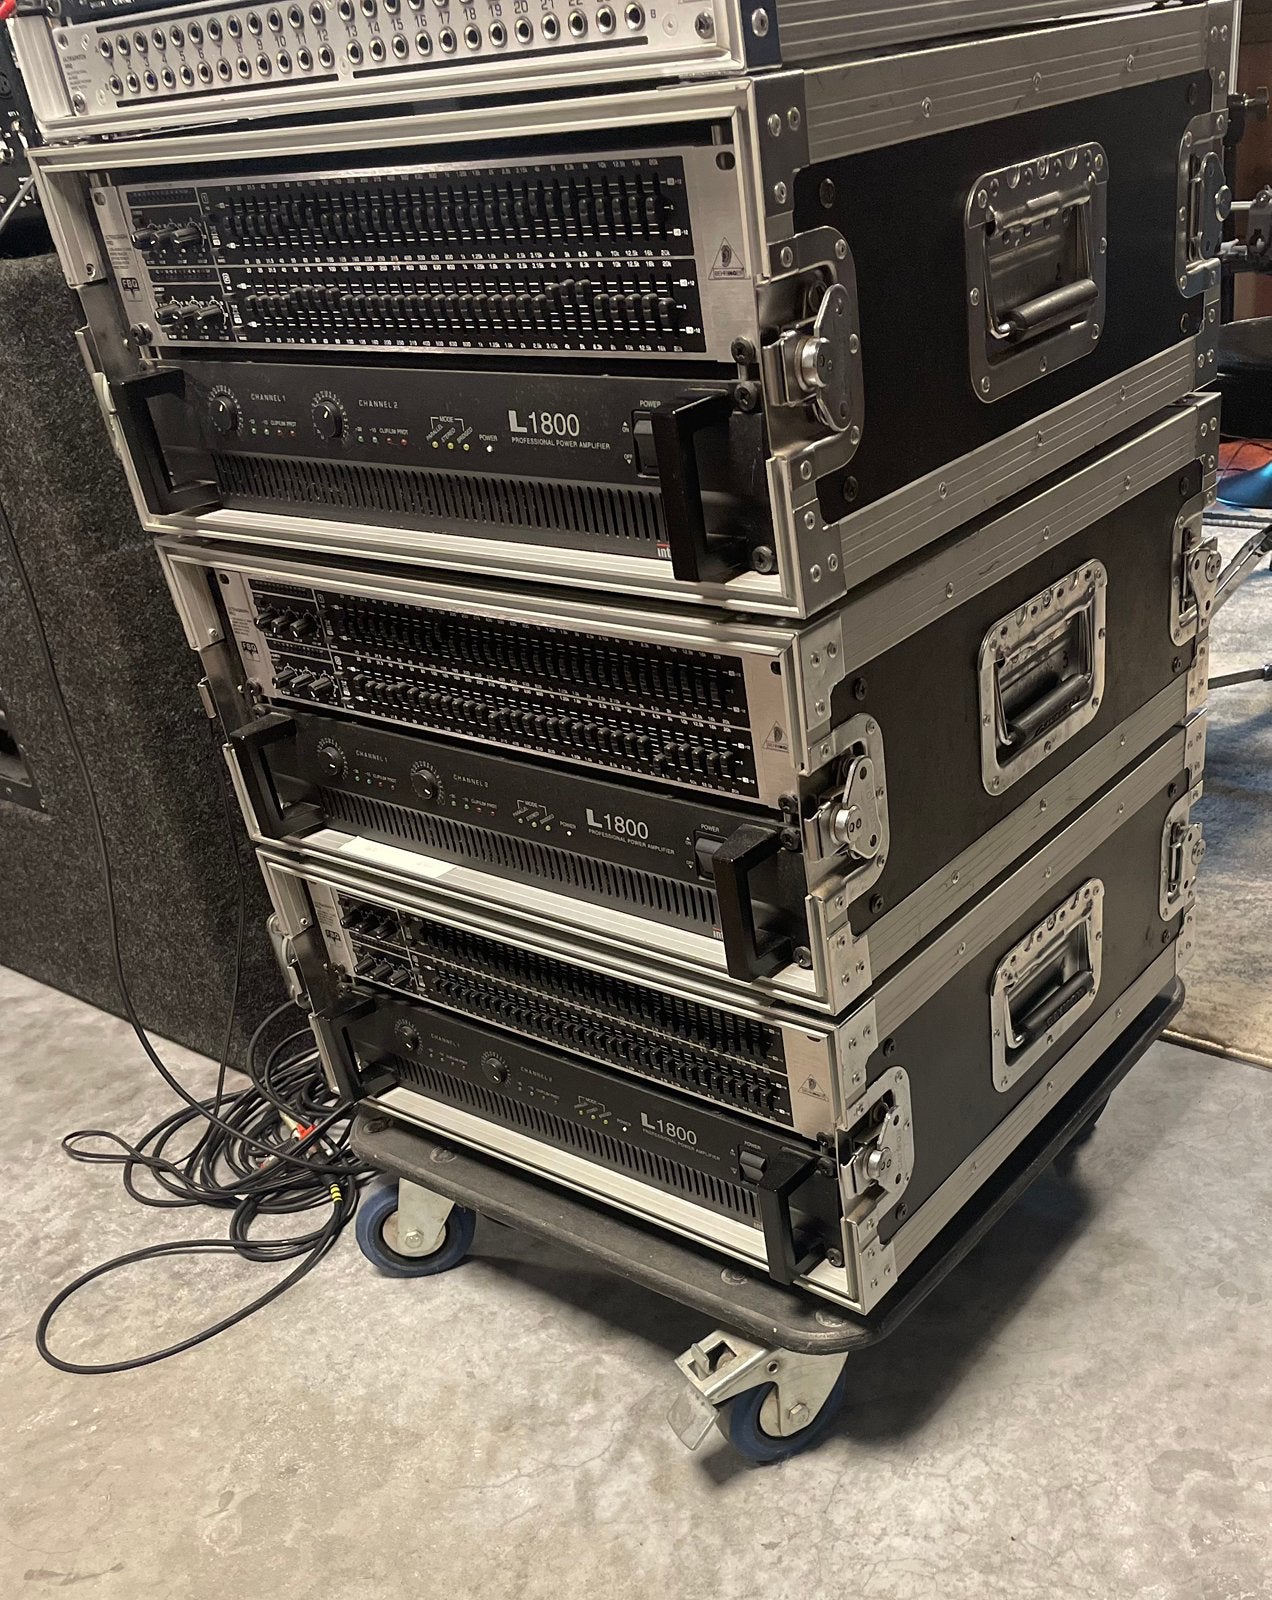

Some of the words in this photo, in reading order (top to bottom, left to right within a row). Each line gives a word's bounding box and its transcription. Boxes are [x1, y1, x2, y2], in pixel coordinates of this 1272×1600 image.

[180, 50, 186, 61] 5
[198, 48, 204, 59] 6
[238, 42, 243, 53] 8
[257, 40, 263, 50] 9
[275, 35, 286, 48] 10
[296, 32, 306, 44] 11
[317, 29, 328, 42] 12
[346, 25, 357, 37] 13
[368, 22, 380, 34] 14
[391, 18, 403, 31] 15
[415, 15, 427, 27] 16
[439, 11, 450, 24] 17
[463, 8, 477, 20] 18
[489, 4, 502, 17] 19
[514, 0, 528, 14] 20
[251, 393, 281, 402] CHANNEL
[358, 400, 392, 408] CHANNEL
[508, 410, 579, 436] L1800
[512, 436, 555, 446] PROFESSIONAL
[579, 441, 610, 450] AMPLIFIER
[453, 774, 483, 787] CHANNEL
[586, 808, 648, 839] L1800
[700, 824, 719, 832] POWER
[589, 828, 626, 843] PROFESSIONAL
[628, 839, 646, 848] POWER
[648, 844, 675, 854] AMPLIFIER
[641, 1112, 697, 1145] L1800
